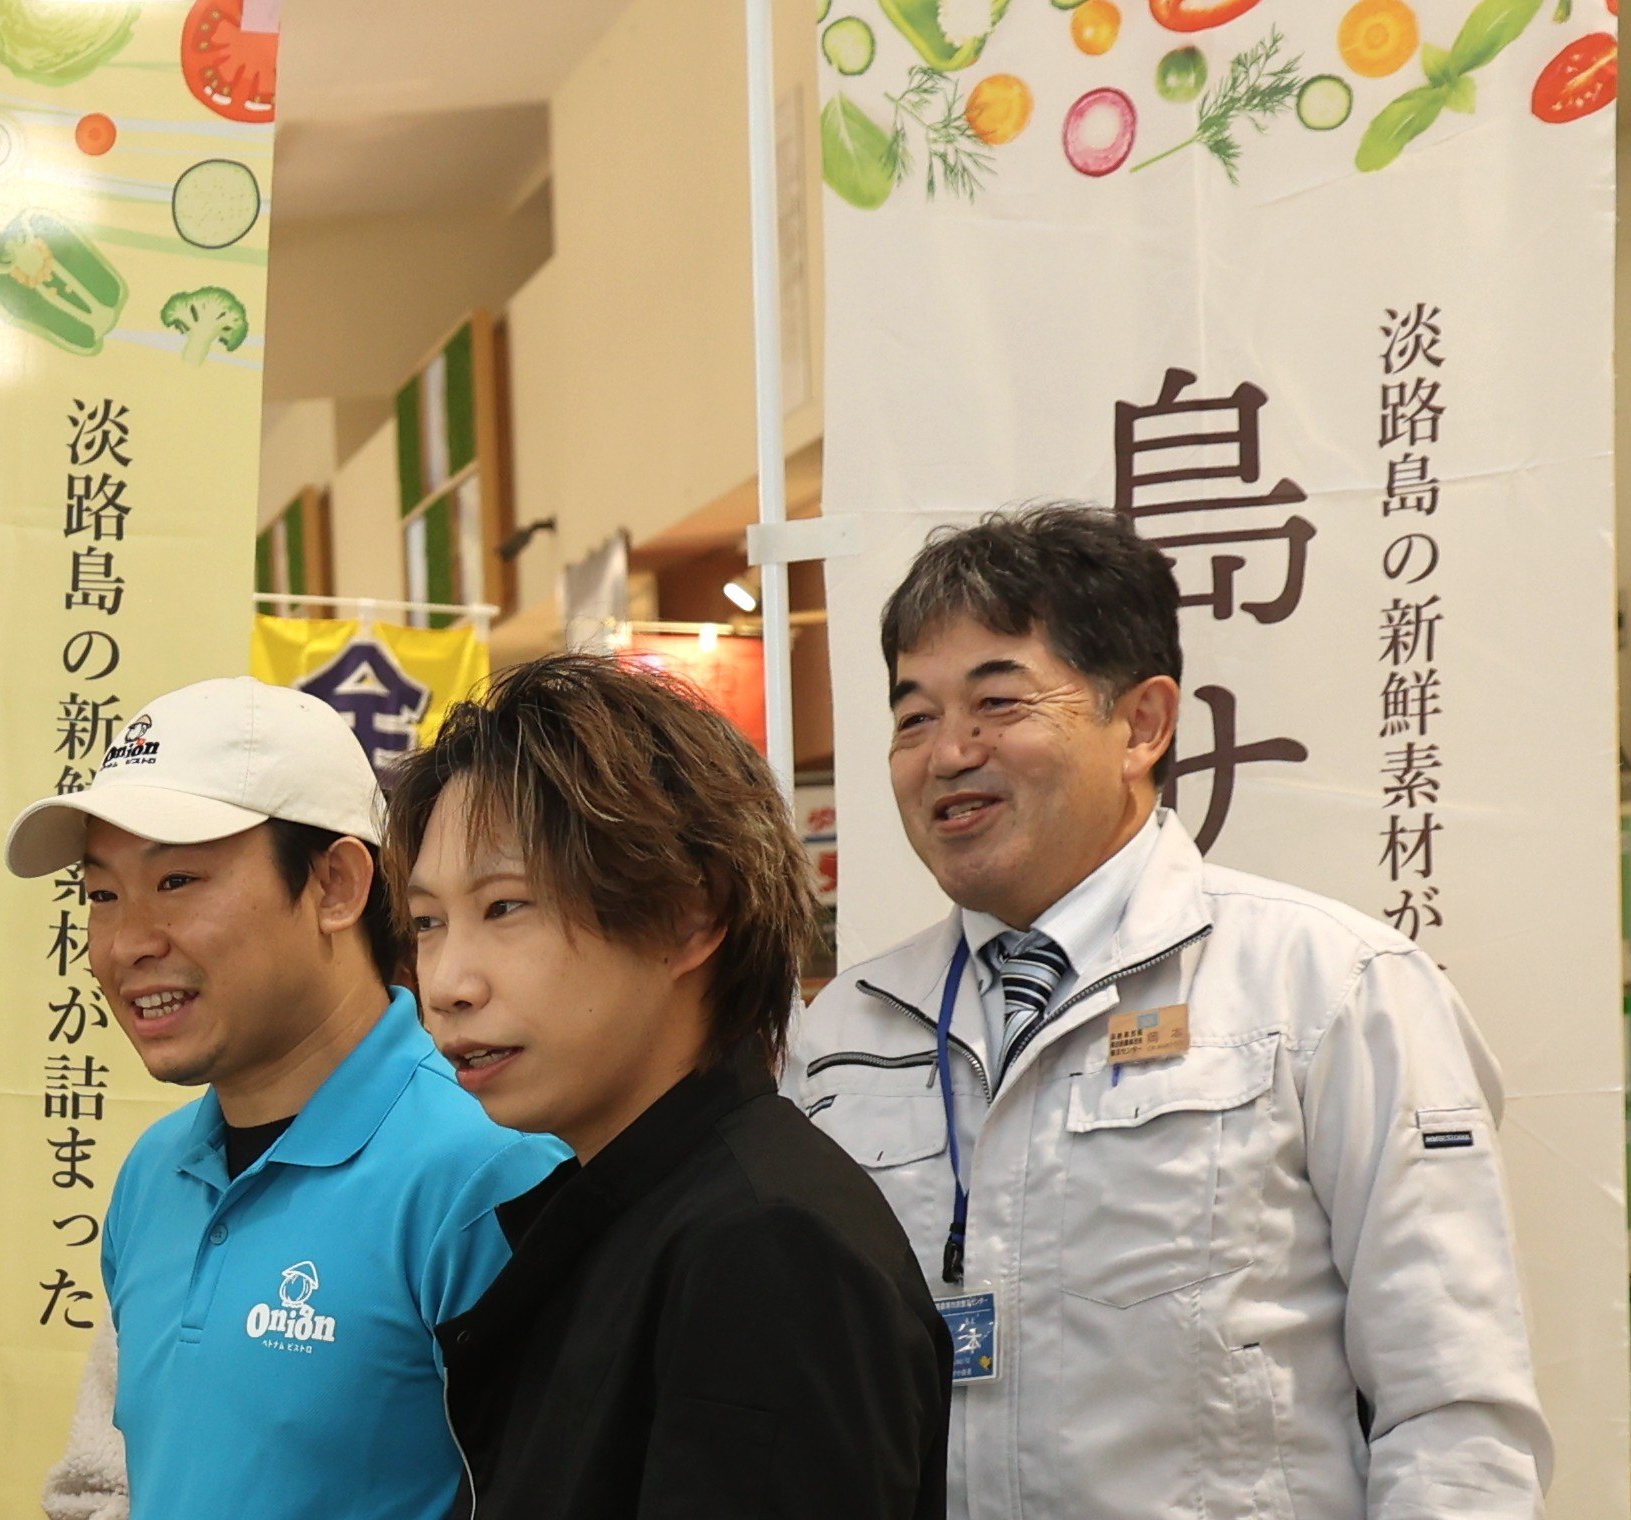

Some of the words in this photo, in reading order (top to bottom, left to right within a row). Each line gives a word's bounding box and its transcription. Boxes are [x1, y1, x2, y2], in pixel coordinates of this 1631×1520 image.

[1375, 302, 1446, 972] 淡路島の新鮮素材が
[246, 1302, 336, 1342] Onion
